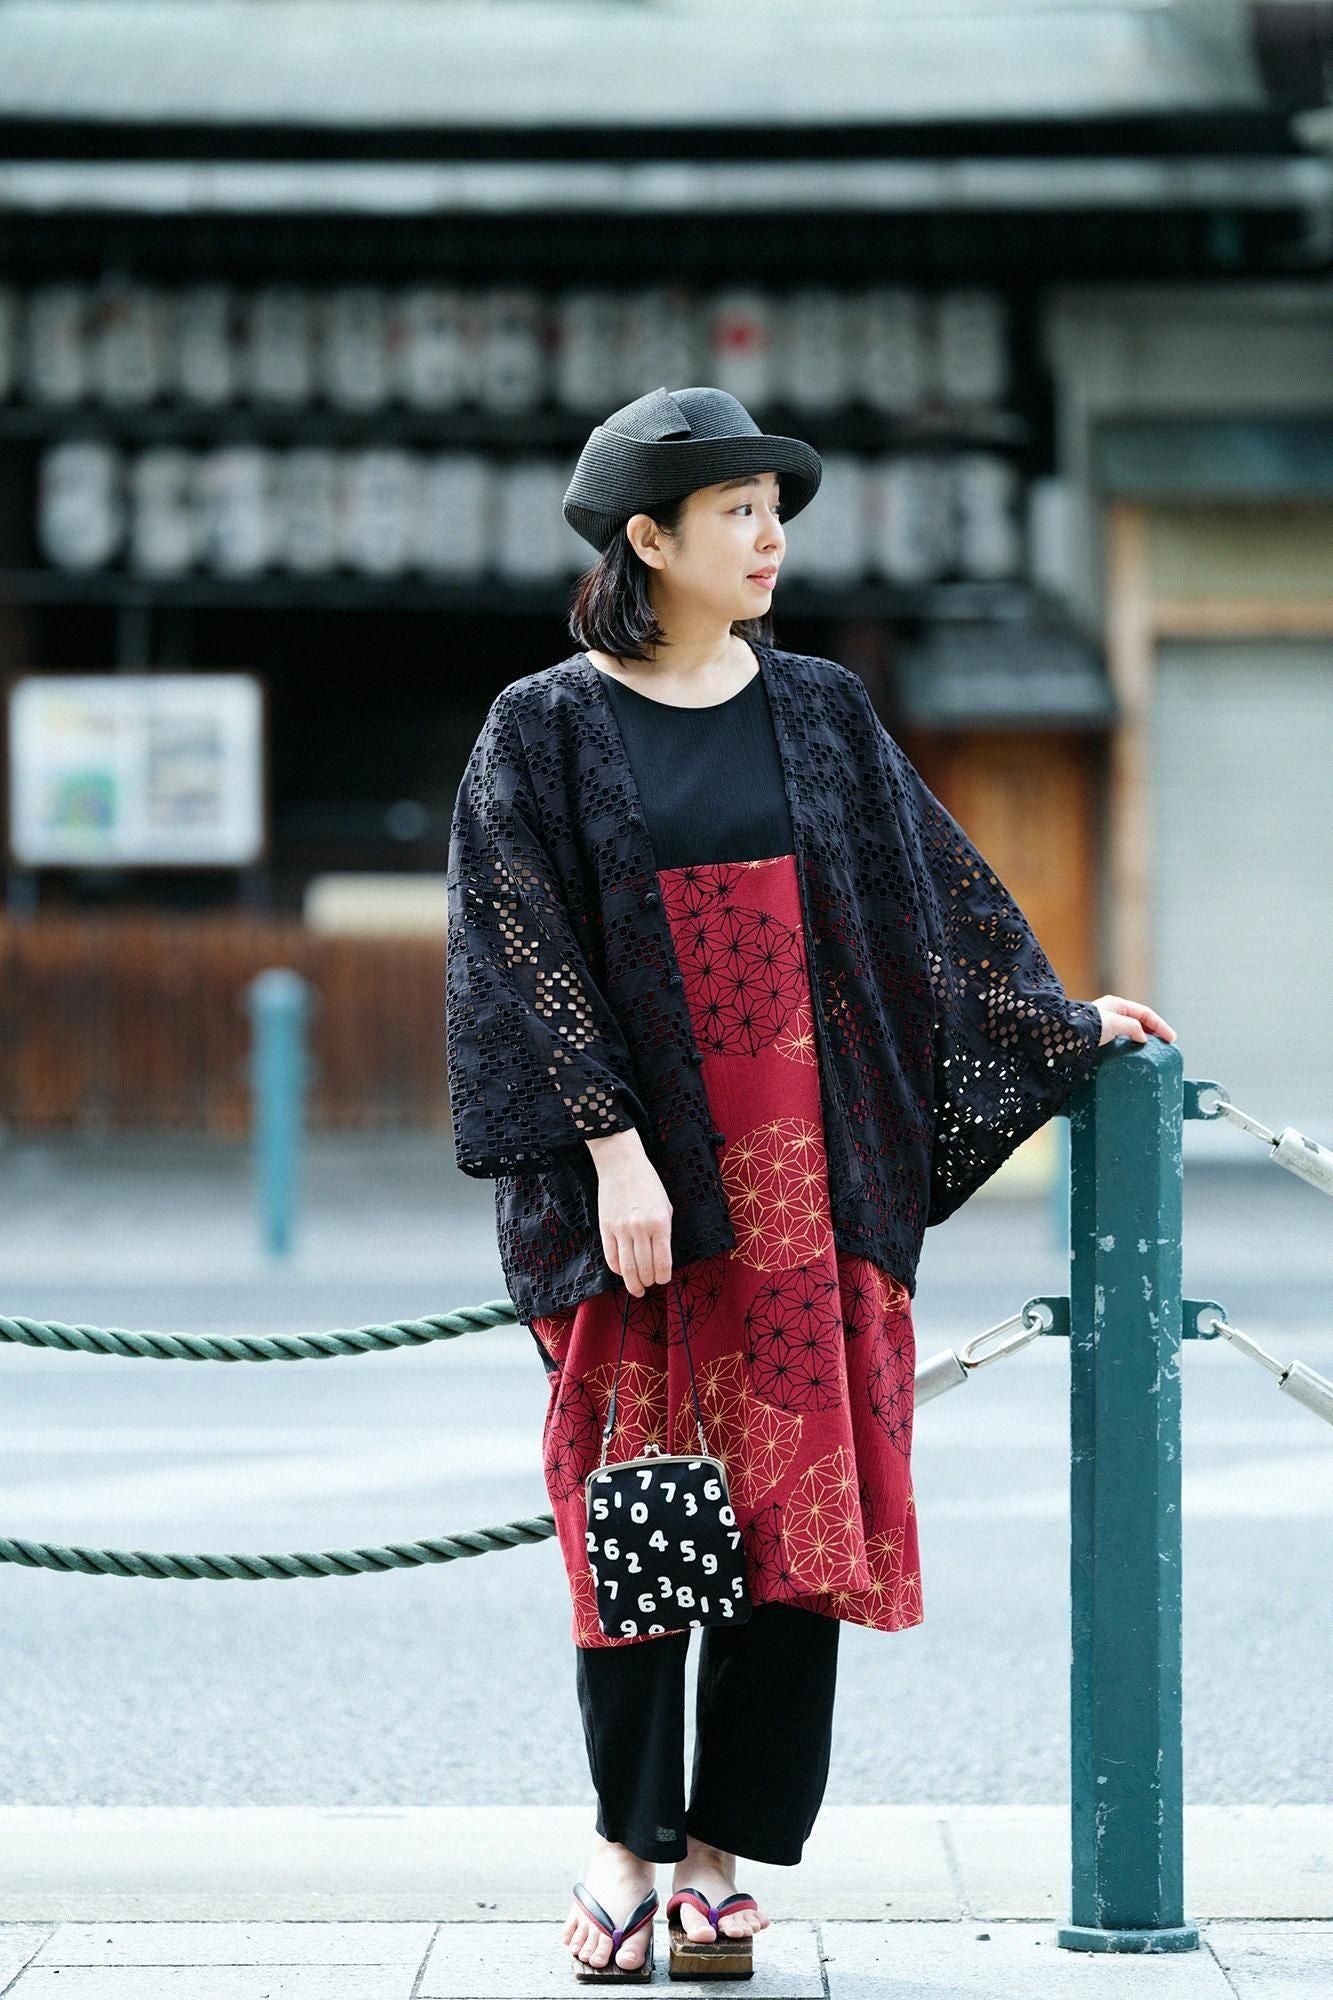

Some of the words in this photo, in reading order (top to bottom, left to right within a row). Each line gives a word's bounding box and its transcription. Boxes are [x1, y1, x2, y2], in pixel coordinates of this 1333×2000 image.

[637, 1470, 652, 1490] 7
[703, 1479, 721, 1500] 6
[614, 1492, 621, 1508] 1
[660, 1482, 676, 1502] 7
[593, 1498, 609, 1520] 5
[630, 1502, 648, 1524] 0
[683, 1493, 698, 1516] 3
[719, 1505, 735, 1526] 0
[585, 1532, 599, 1552] 2
[604, 1538, 619, 1560] 6
[648, 1530, 668, 1552] 4
[680, 1540, 696, 1562] 5
[727, 1531, 741, 1550] 7
[625, 1552, 642, 1573] 2
[702, 1554, 717, 1575] 9
[604, 1580, 618, 1600] 7
[657, 1576, 673, 1598] 3
[676, 1586, 695, 1608] 8
[731, 1577, 743, 1598] 5
[637, 1593, 656, 1612] 6
[700, 1596, 709, 1613] 1
[719, 1598, 734, 1618] 3
[620, 1619, 638, 1639] 9
